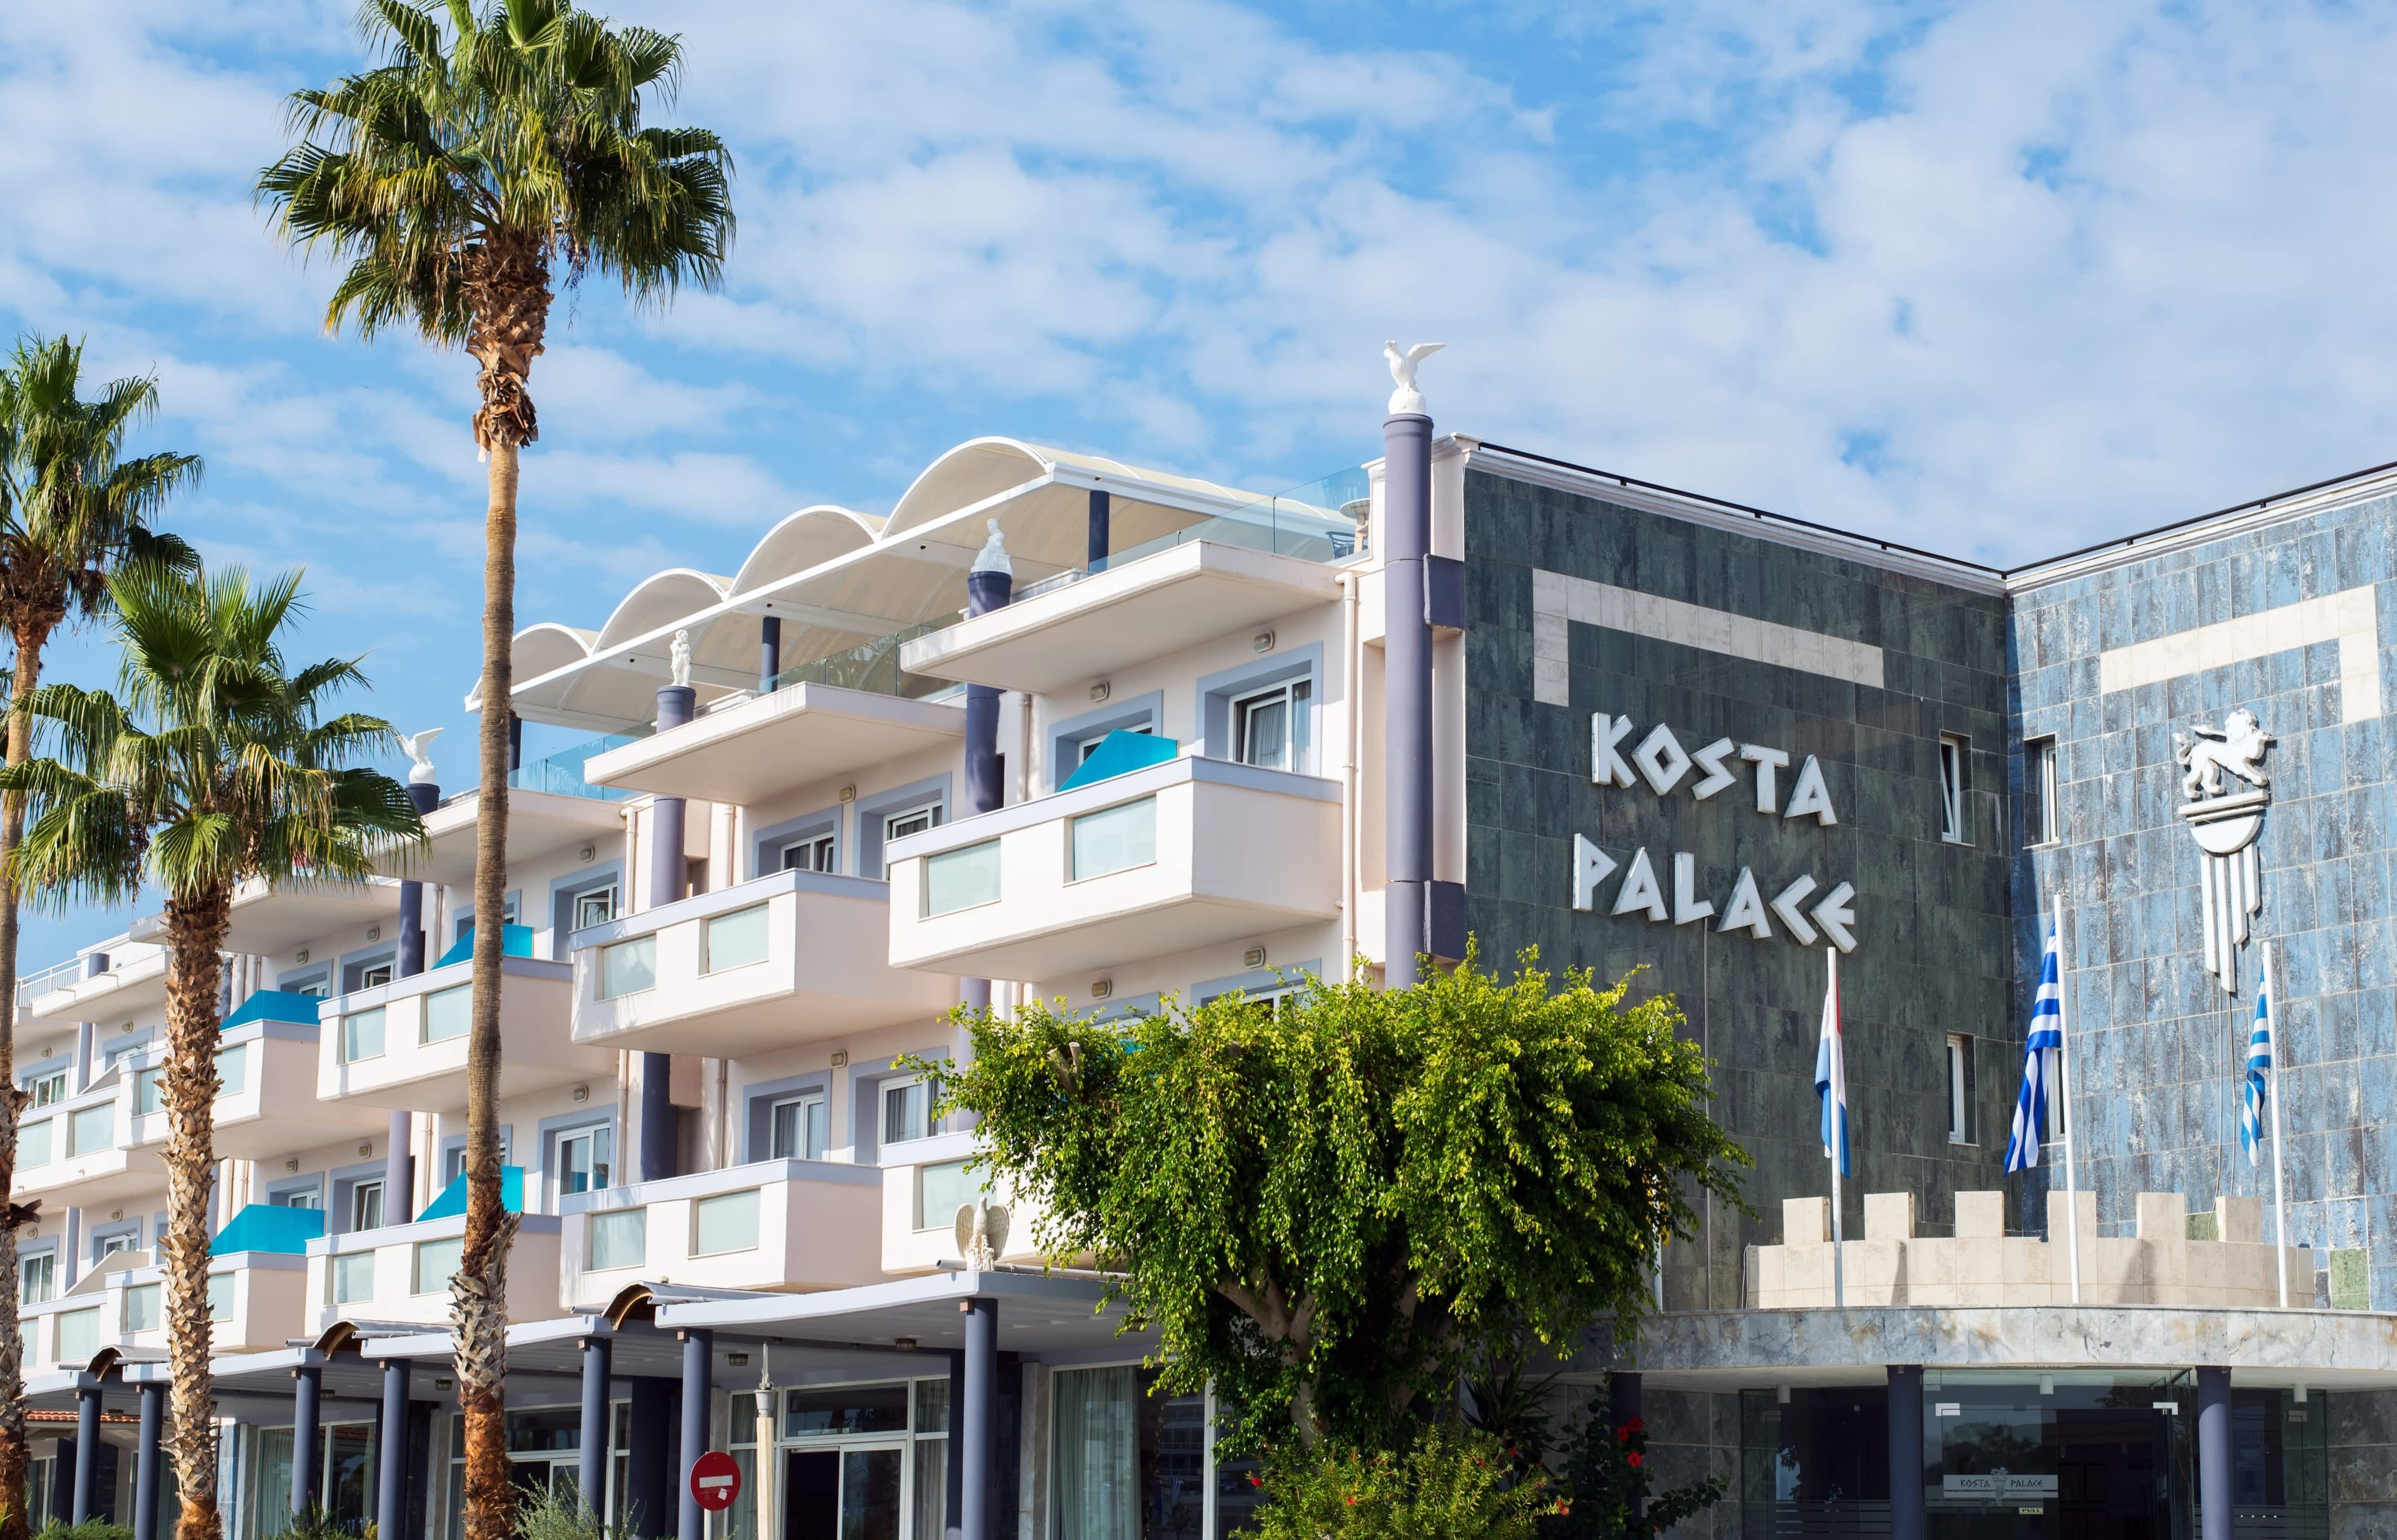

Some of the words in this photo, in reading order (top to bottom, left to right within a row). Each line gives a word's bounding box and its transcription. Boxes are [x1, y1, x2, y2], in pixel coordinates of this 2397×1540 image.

[1591, 712, 1838, 826] KOSTA
[1572, 833, 1858, 954] PALACE
[1960, 1479, 1990, 1488] KOSTA
[2011, 1479, 2043, 1488] PALACE
